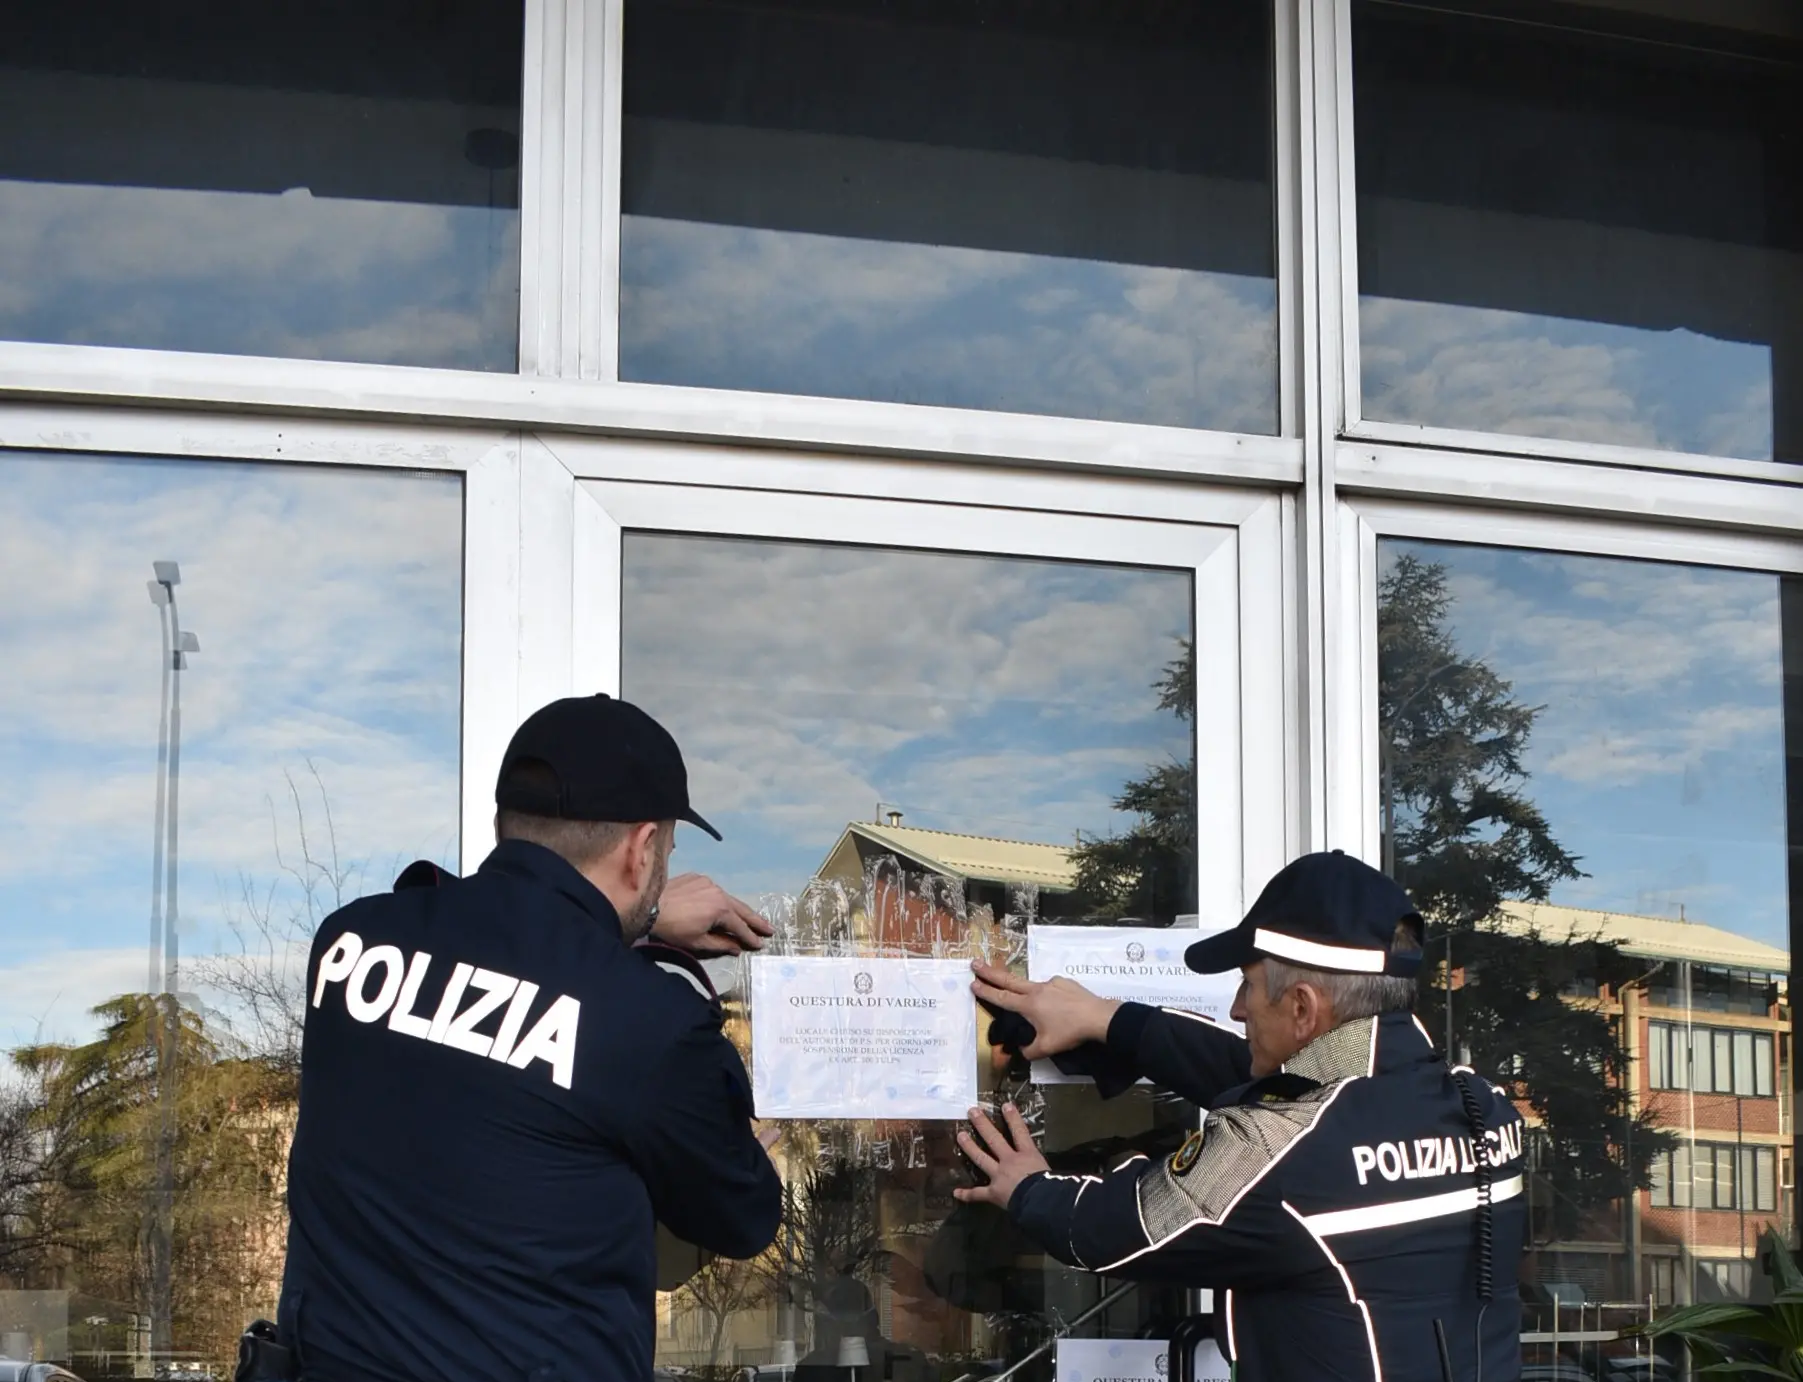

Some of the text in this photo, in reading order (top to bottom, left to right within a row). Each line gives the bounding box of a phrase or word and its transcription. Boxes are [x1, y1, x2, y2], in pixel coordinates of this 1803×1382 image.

[1065, 965, 1198, 976] QUESTURA DI VARE
[789, 996, 938, 1009] QUESTURA DI VARESE
[312, 931, 581, 1090] POLIZIA
[861, 1047, 887, 1055] DELLA
[889, 1047, 925, 1056] LICENZA
[1352, 1137, 1458, 1186] POLIZIA
